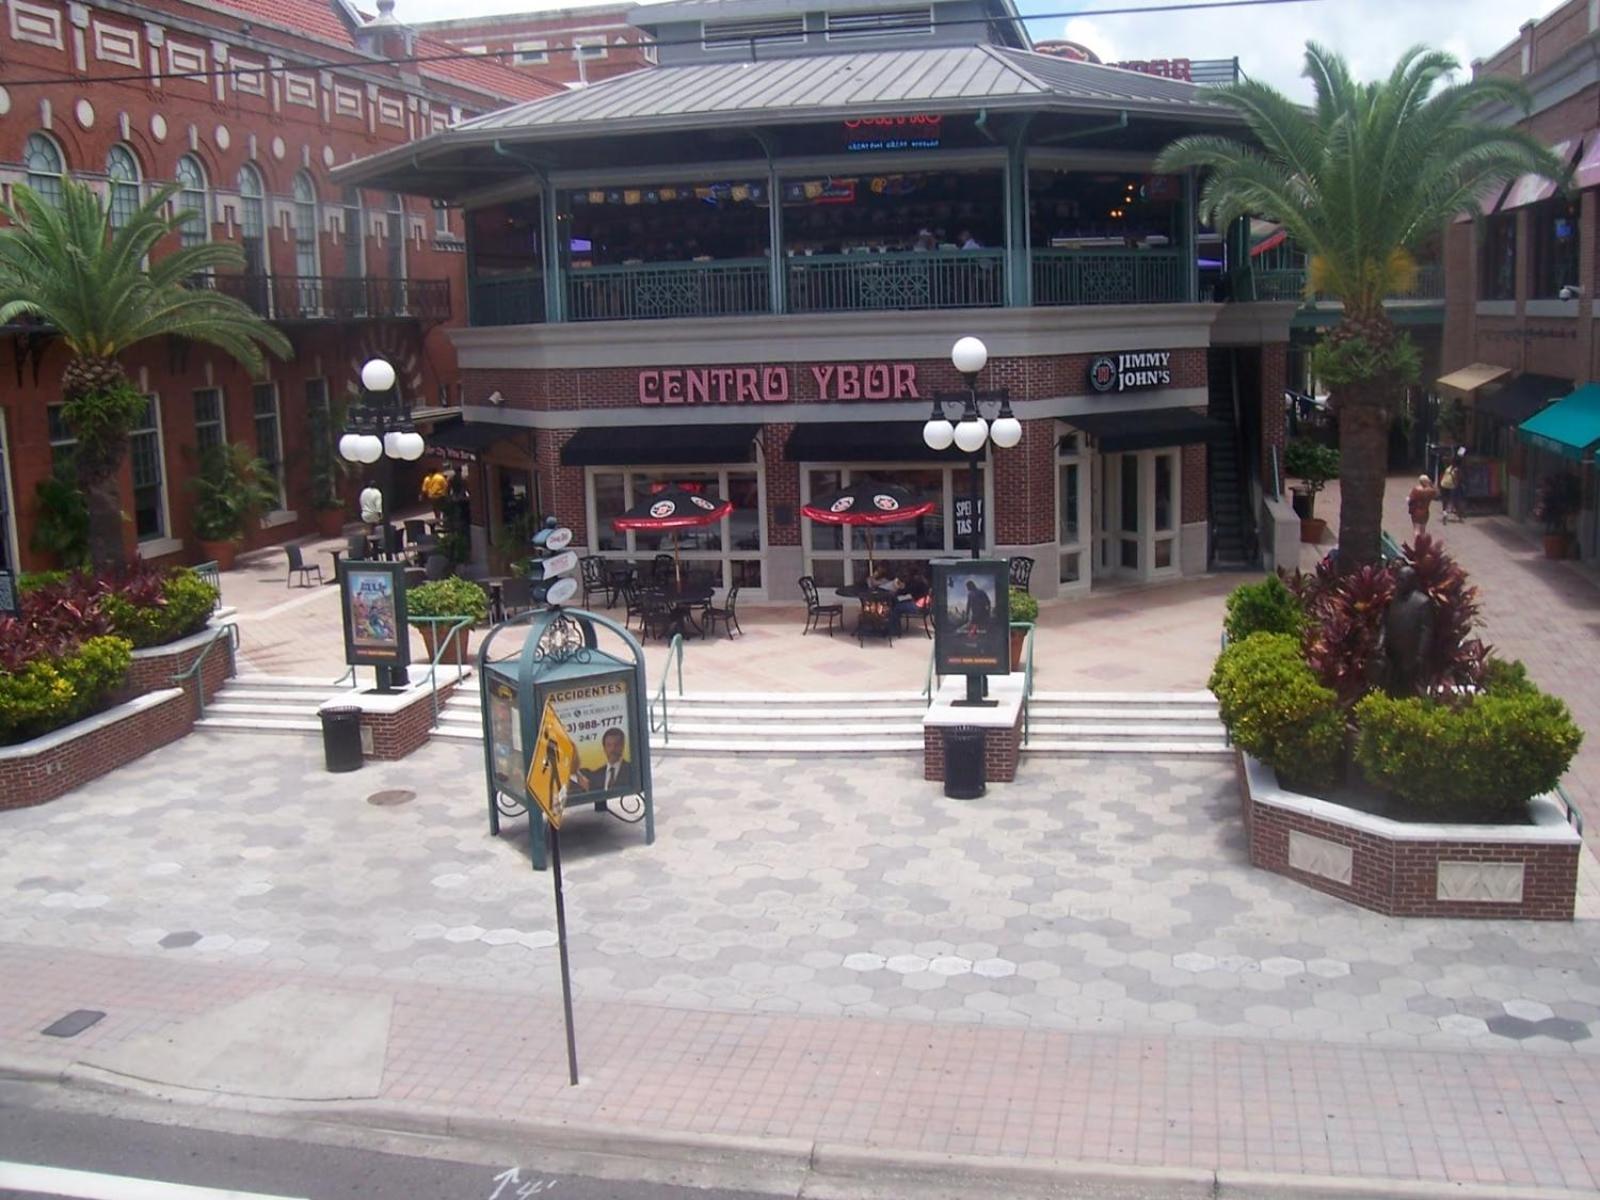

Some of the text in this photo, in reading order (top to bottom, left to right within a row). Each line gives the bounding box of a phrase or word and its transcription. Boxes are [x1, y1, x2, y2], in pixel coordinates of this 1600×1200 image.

[1118, 352, 1170, 372] JIMMY
[639, 363, 919, 404] CENTRO YBOR
[1118, 370, 1170, 391] JOHN'S
[549, 683, 623, 702] ACCIDENTES
[578, 715, 624, 731] 988-1777
[580, 733, 598, 742] 24/7
